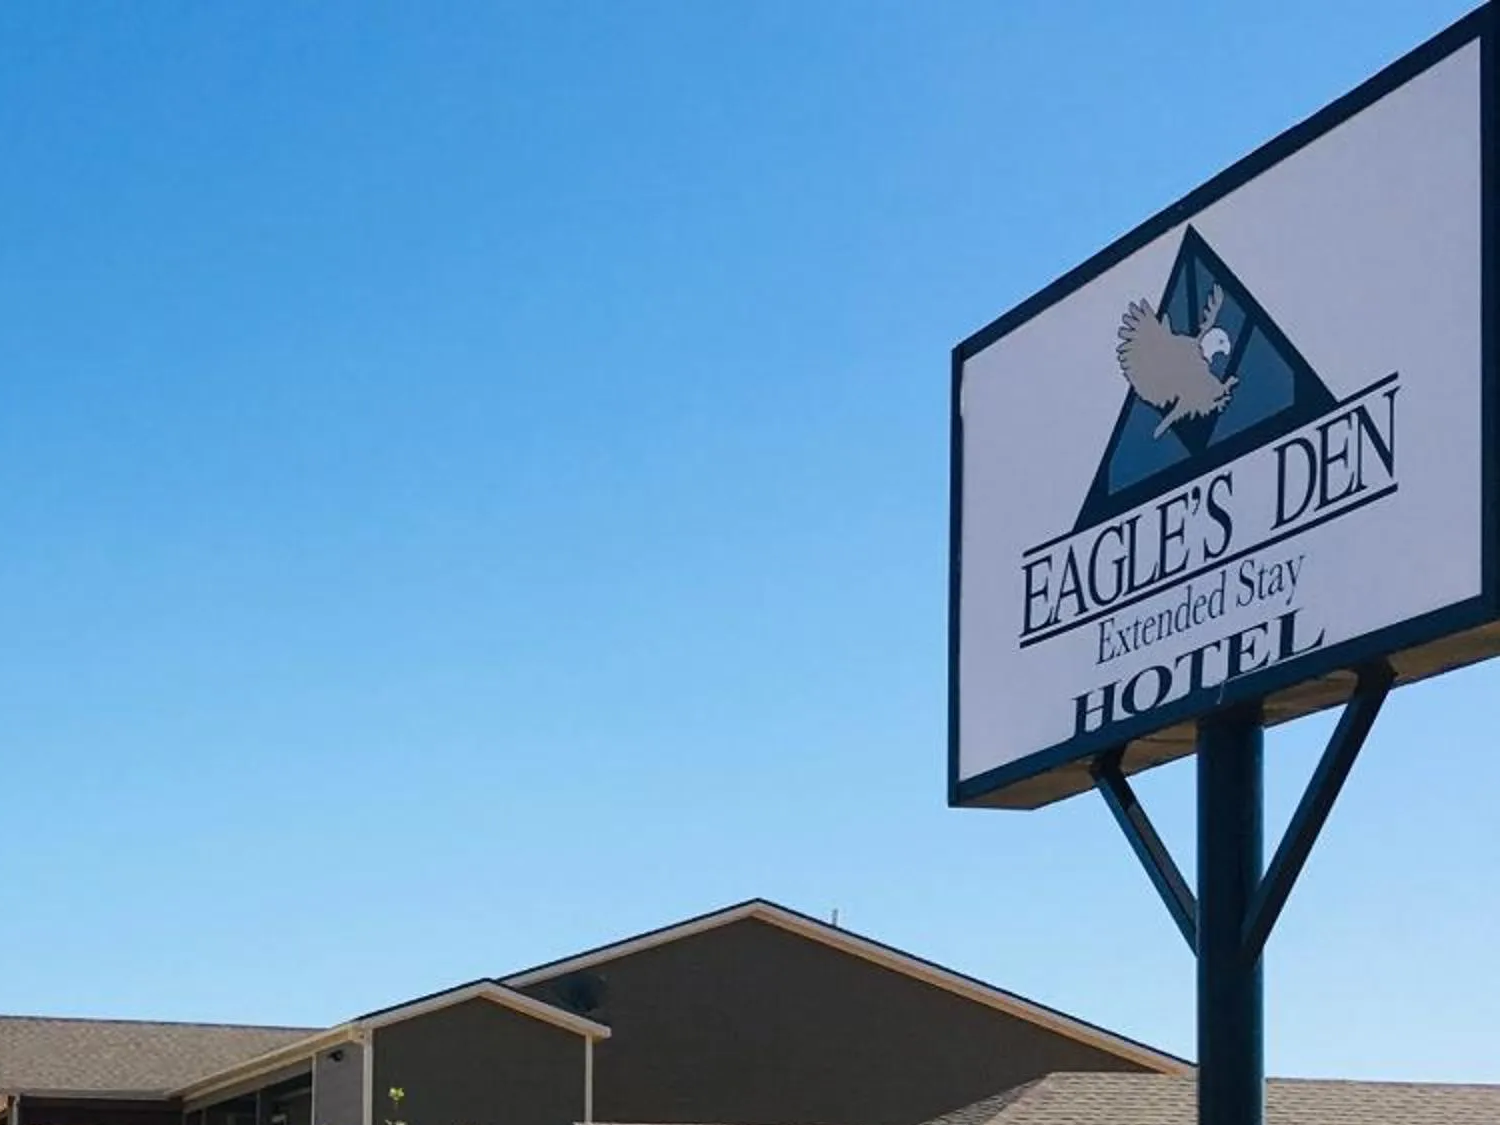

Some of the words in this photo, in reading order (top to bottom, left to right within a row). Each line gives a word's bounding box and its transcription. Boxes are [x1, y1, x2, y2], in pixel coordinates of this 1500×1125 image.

[1019, 471, 1234, 638] EAGLE'S
[1271, 386, 1401, 532] DEN
[1072, 608, 1325, 734] HOTEL
[1096, 569, 1227, 665] Extended
[1236, 554, 1305, 606] Stay
